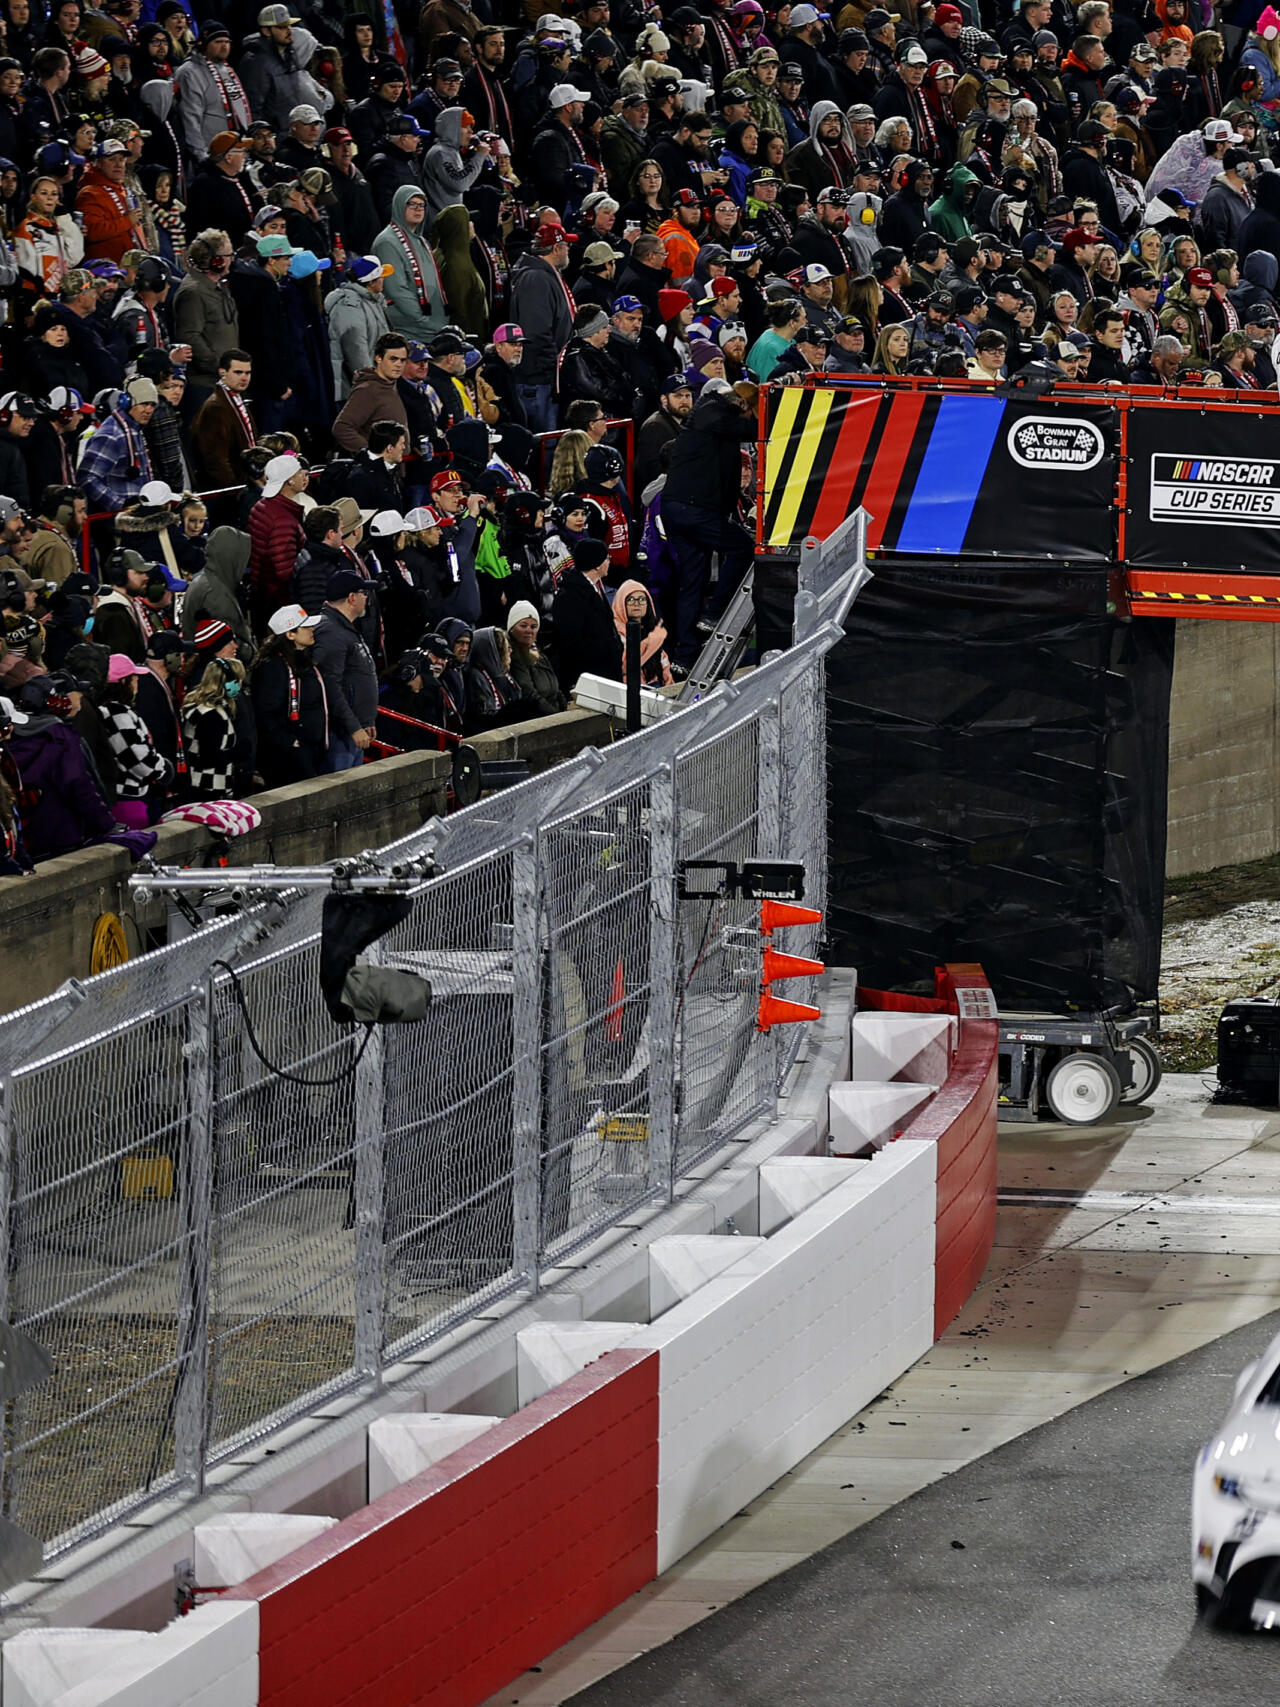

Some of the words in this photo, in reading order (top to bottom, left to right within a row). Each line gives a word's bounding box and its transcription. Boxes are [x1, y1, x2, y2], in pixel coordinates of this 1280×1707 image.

[665, 83, 676, 92] 3
[1012, 280, 1021, 290] 8
[1037, 425, 1076, 437] BOWMAN
[1043, 436, 1069, 446] GRAY
[1025, 447, 1087, 462] STADIUM
[1197, 462, 1275, 485] NASCAR
[1170, 490, 1208, 508] CUP
[1209, 492, 1275, 513] SERIES
[752, 888, 796, 899] WHELEN
